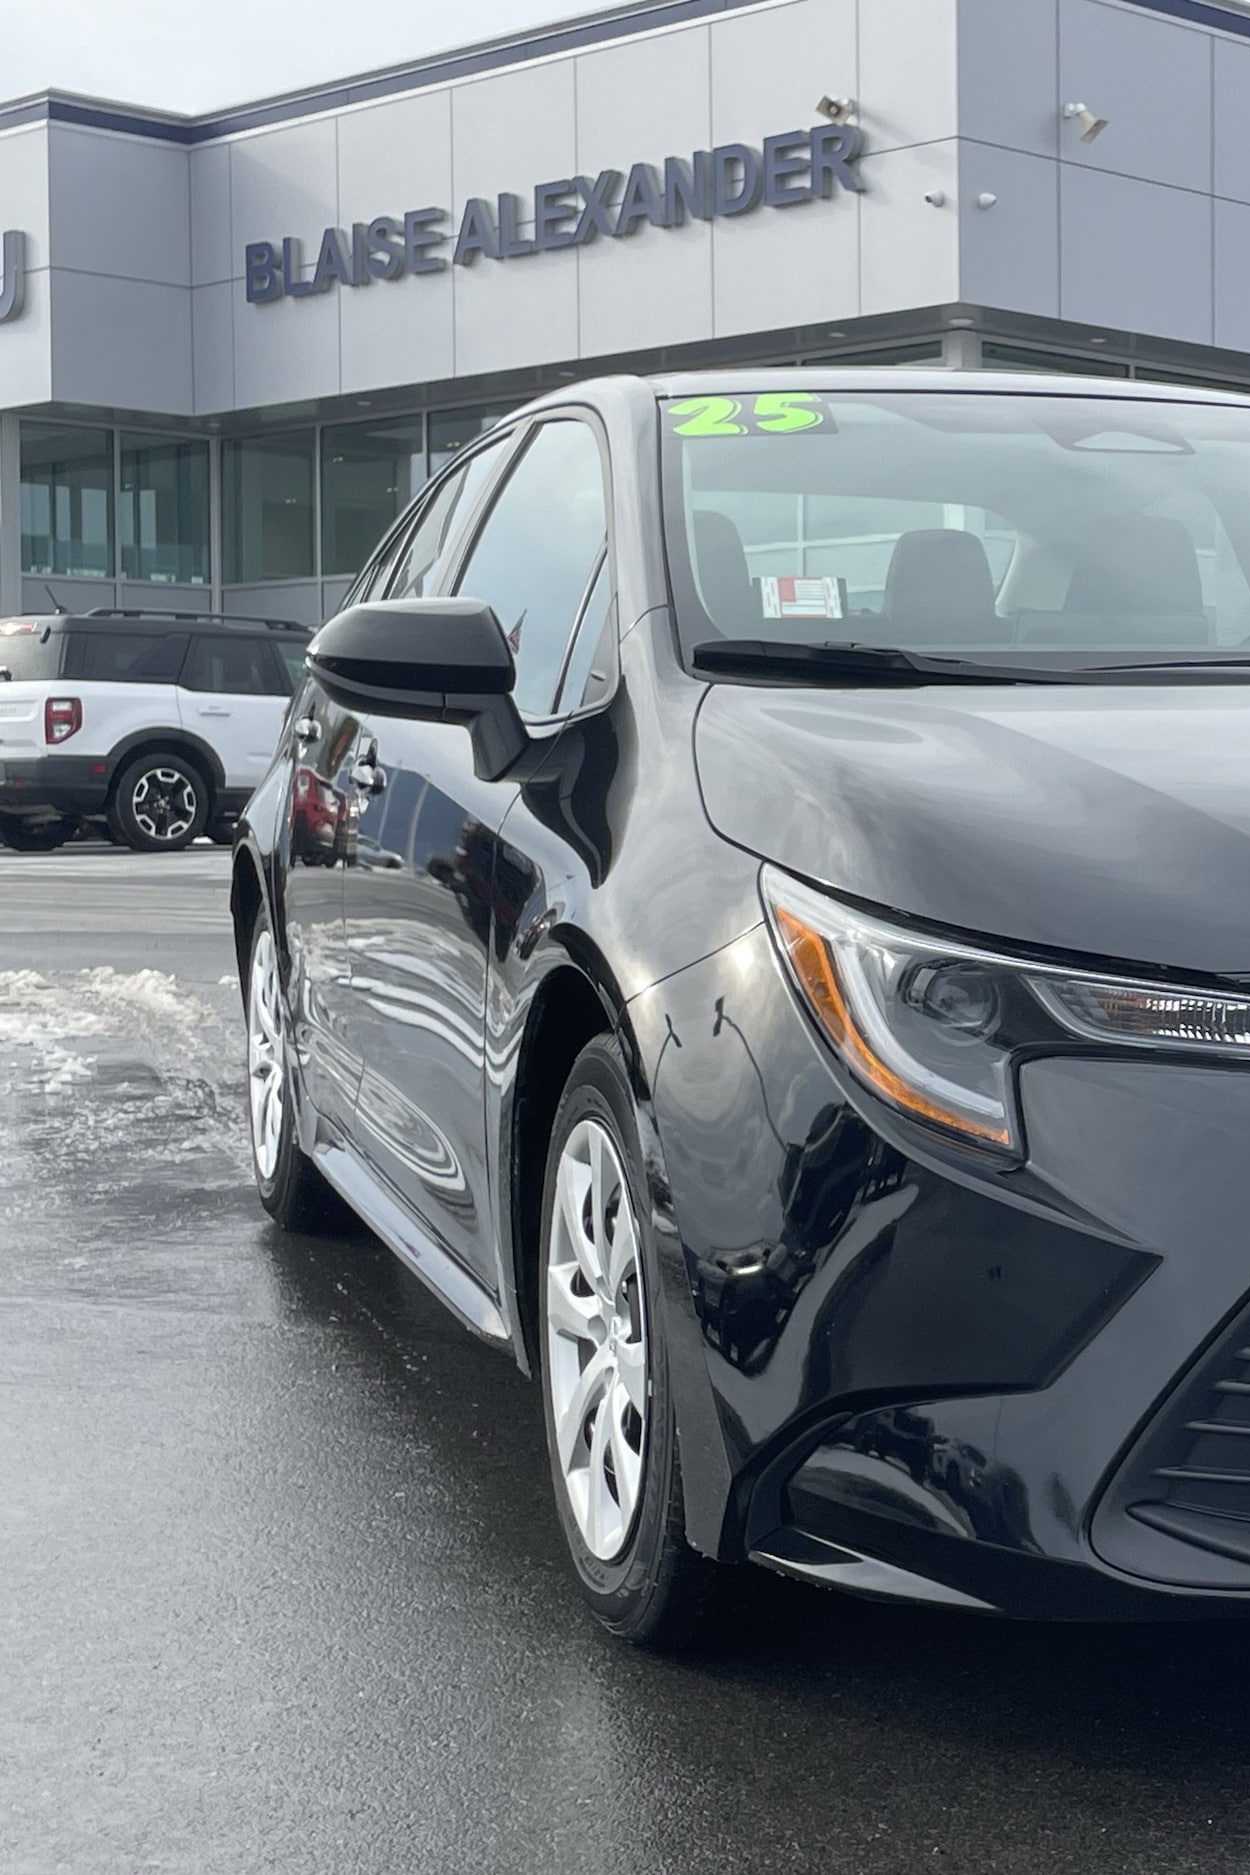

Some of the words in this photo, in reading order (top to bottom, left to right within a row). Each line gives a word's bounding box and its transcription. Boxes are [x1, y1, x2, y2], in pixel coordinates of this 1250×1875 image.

[245, 207, 448, 305] BLAISE
[453, 122, 867, 265] ALEXANDER
[667, 392, 824, 436] 25
